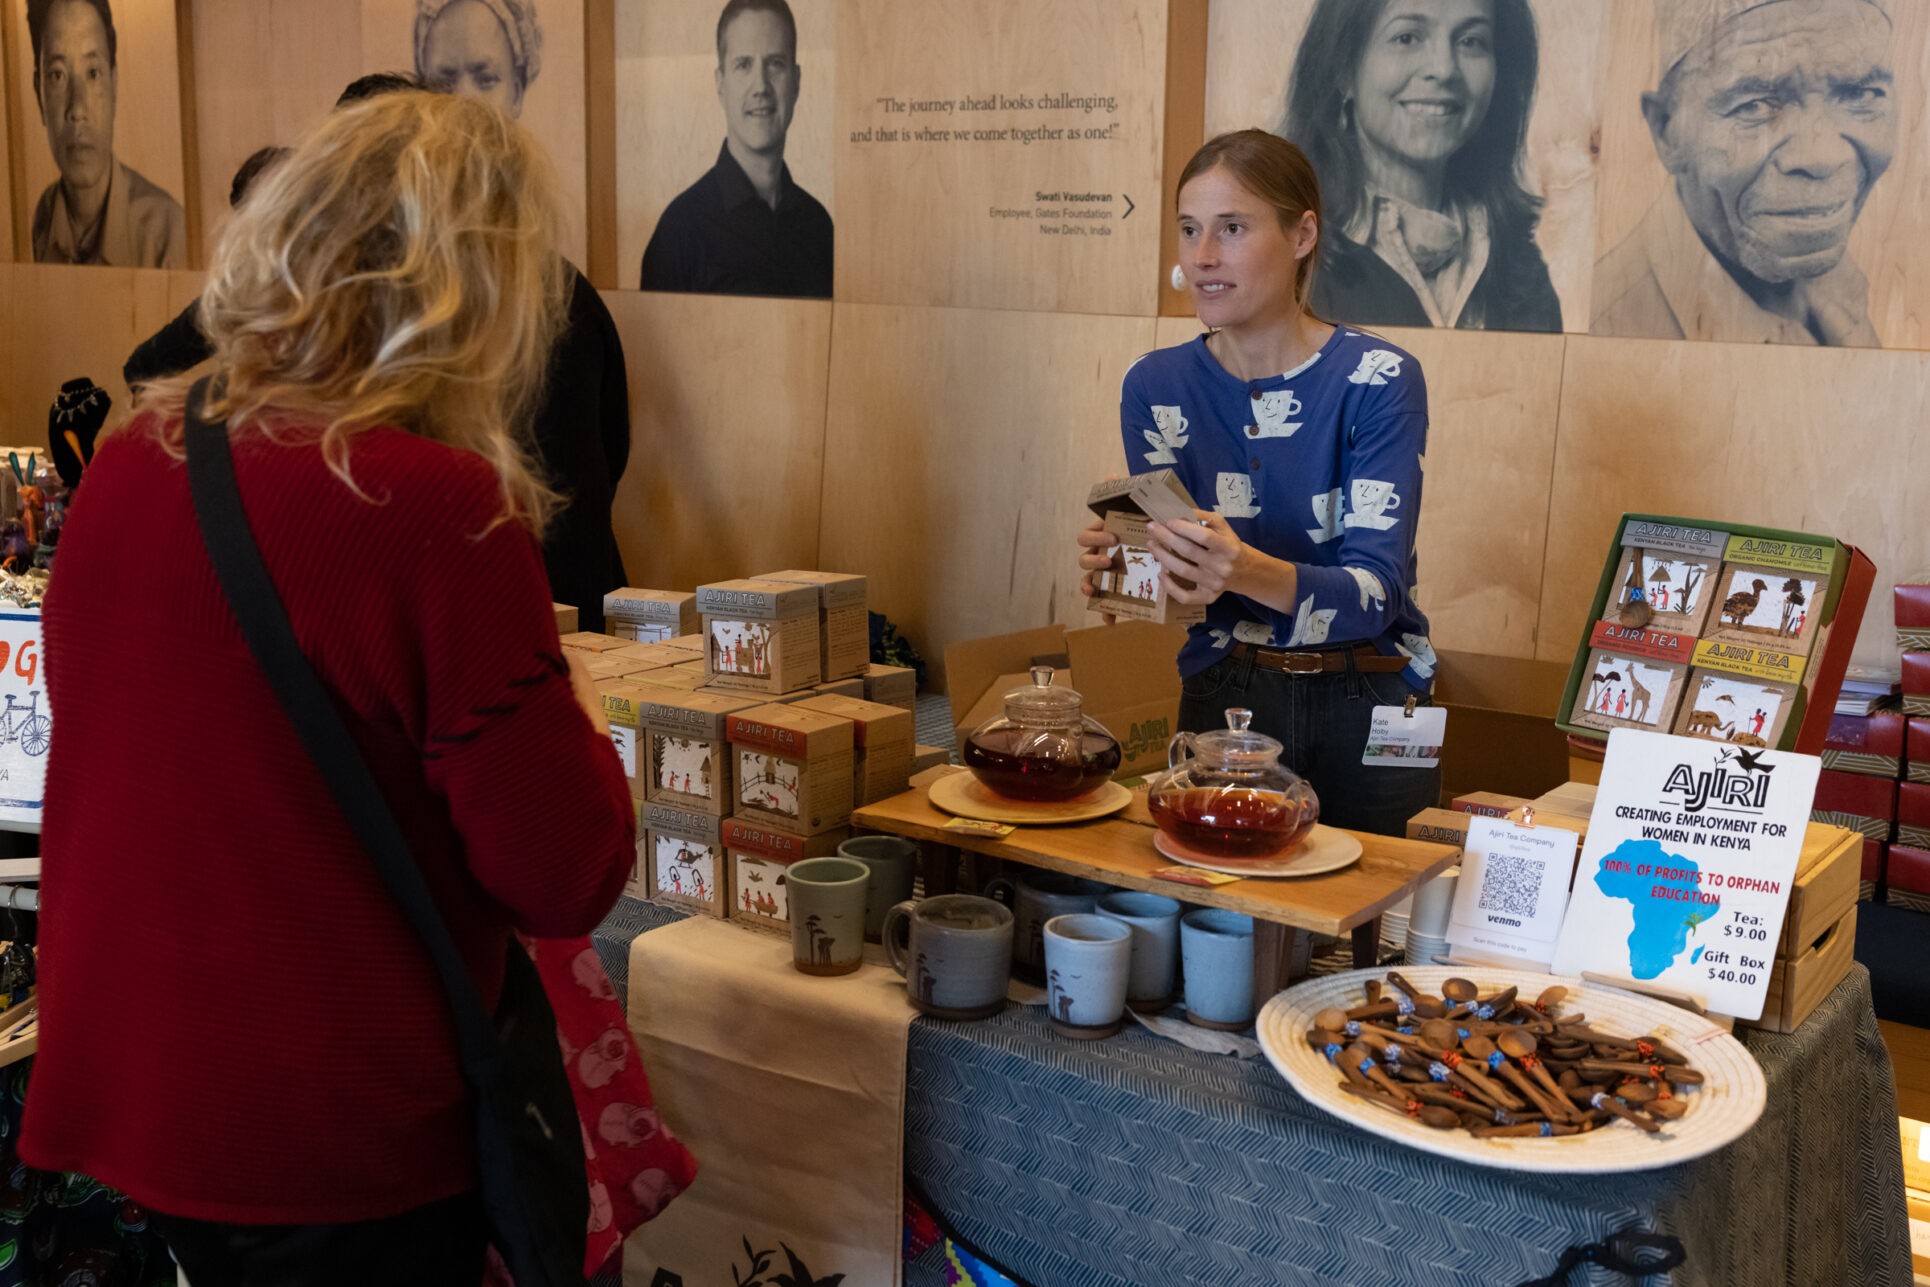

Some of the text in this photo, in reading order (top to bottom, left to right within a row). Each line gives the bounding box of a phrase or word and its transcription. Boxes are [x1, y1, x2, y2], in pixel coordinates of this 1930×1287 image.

[908, 98, 955, 116] journey
[959, 95, 996, 111] ahead
[1000, 94, 1034, 110] looks
[1038, 93, 1118, 113] challenging,
[850, 127, 872, 142] and
[875, 127, 898, 142] that
[901, 128, 910, 142] is
[914, 126, 950, 142] where
[953, 129, 971, 141] we
[974, 129, 1008, 141] come
[1011, 125, 1062, 145] together
[1067, 128, 1081, 139] as
[1036, 191, 1112, 202] Swati Vasudevan
[989, 207, 1112, 219] Employee, Gates Foundation
[1040, 224, 1060, 234] New
[1089, 225, 1112, 236] India
[1635, 523, 1712, 544] AJIRI TEA
[1740, 539, 1823, 561] AJIRI TEA
[647, 601, 671, 613] TEA
[705, 589, 766, 607] AJIRI TEA
[1604, 625, 1646, 642] AJIRI
[1650, 633, 1679, 648] TEA
[1706, 644, 1754, 662] AJIRI
[1757, 651, 1790, 669] TEA
[1741, 665, 1753, 673] TEA
[609, 696, 630, 712] TEA
[648, 704, 680, 720] AJIRI
[683, 709, 706, 725] TEA
[736, 721, 767, 737] AJIRI
[772, 728, 794, 745] TEA
[1662, 764, 1770, 812] AJIRI
[651, 806, 709, 830] AJIRI TEA
[1615, 805, 1787, 838] CREATING EMPLOYMENT FOR
[732, 827, 764, 843] AJIRI
[768, 835, 792, 850] TEA
[1418, 825, 1460, 843] AJIRI
[1489, 829, 1504, 839] Ajiri
[1507, 831, 1519, 841] Tea
[1520, 834, 1555, 849] Company
[1641, 826, 1751, 851] WOMEN IN KENYA
[1604, 858, 1780, 895] 100% OF PROFITS TO ORPHAN
[1651, 885, 1721, 907] EDUCATION
[1488, 914, 1522, 928] venmo
[1733, 911, 1764, 927] Tea:
[1704, 949, 1766, 970] Gift Box
[1708, 968, 1756, 985] $40.00
